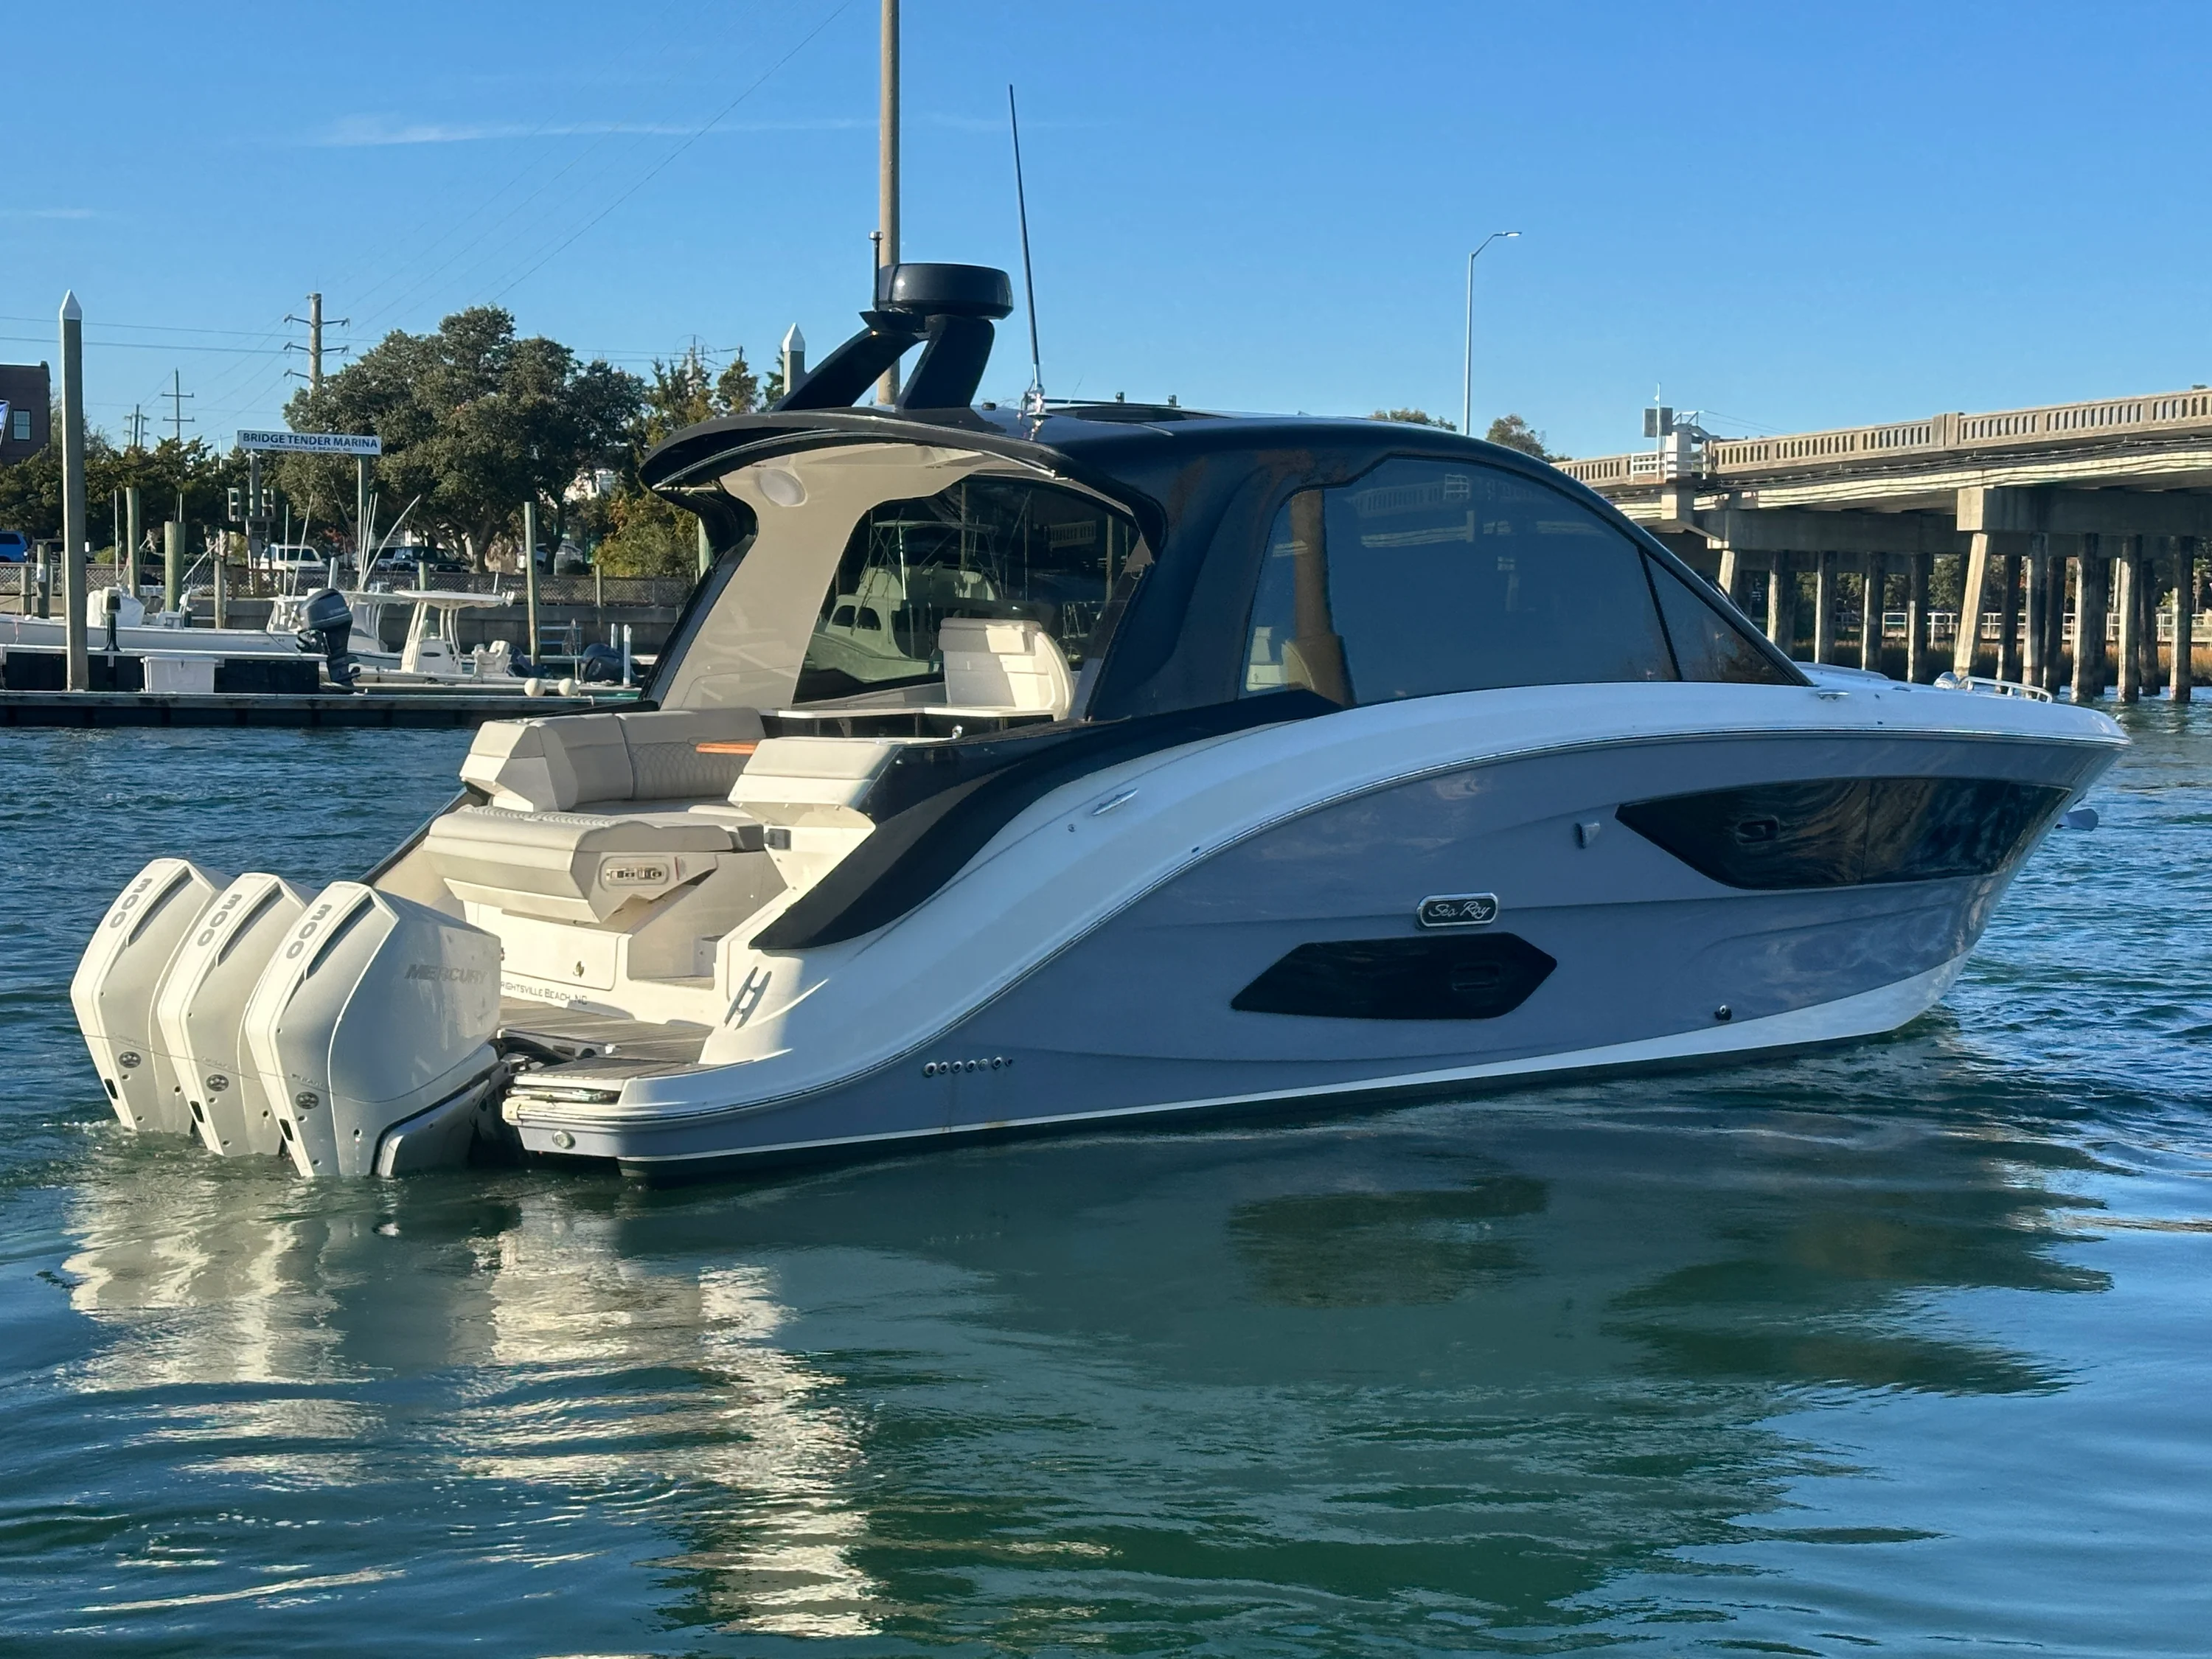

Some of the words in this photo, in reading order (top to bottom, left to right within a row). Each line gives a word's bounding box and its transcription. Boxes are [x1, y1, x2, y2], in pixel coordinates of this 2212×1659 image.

[243, 433, 285, 443] BRIDGE
[288, 436, 331, 445] TENDER
[333, 438, 378, 448] MARINA
[109, 878, 153, 928] 300
[1428, 904, 1458, 917] Sea
[1460, 901, 1491, 919] Ray
[197, 894, 242, 947] 300
[286, 904, 333, 959] 300
[405, 964, 487, 984] MERCURY
[500, 981, 543, 998] RIGHTSVILLE
